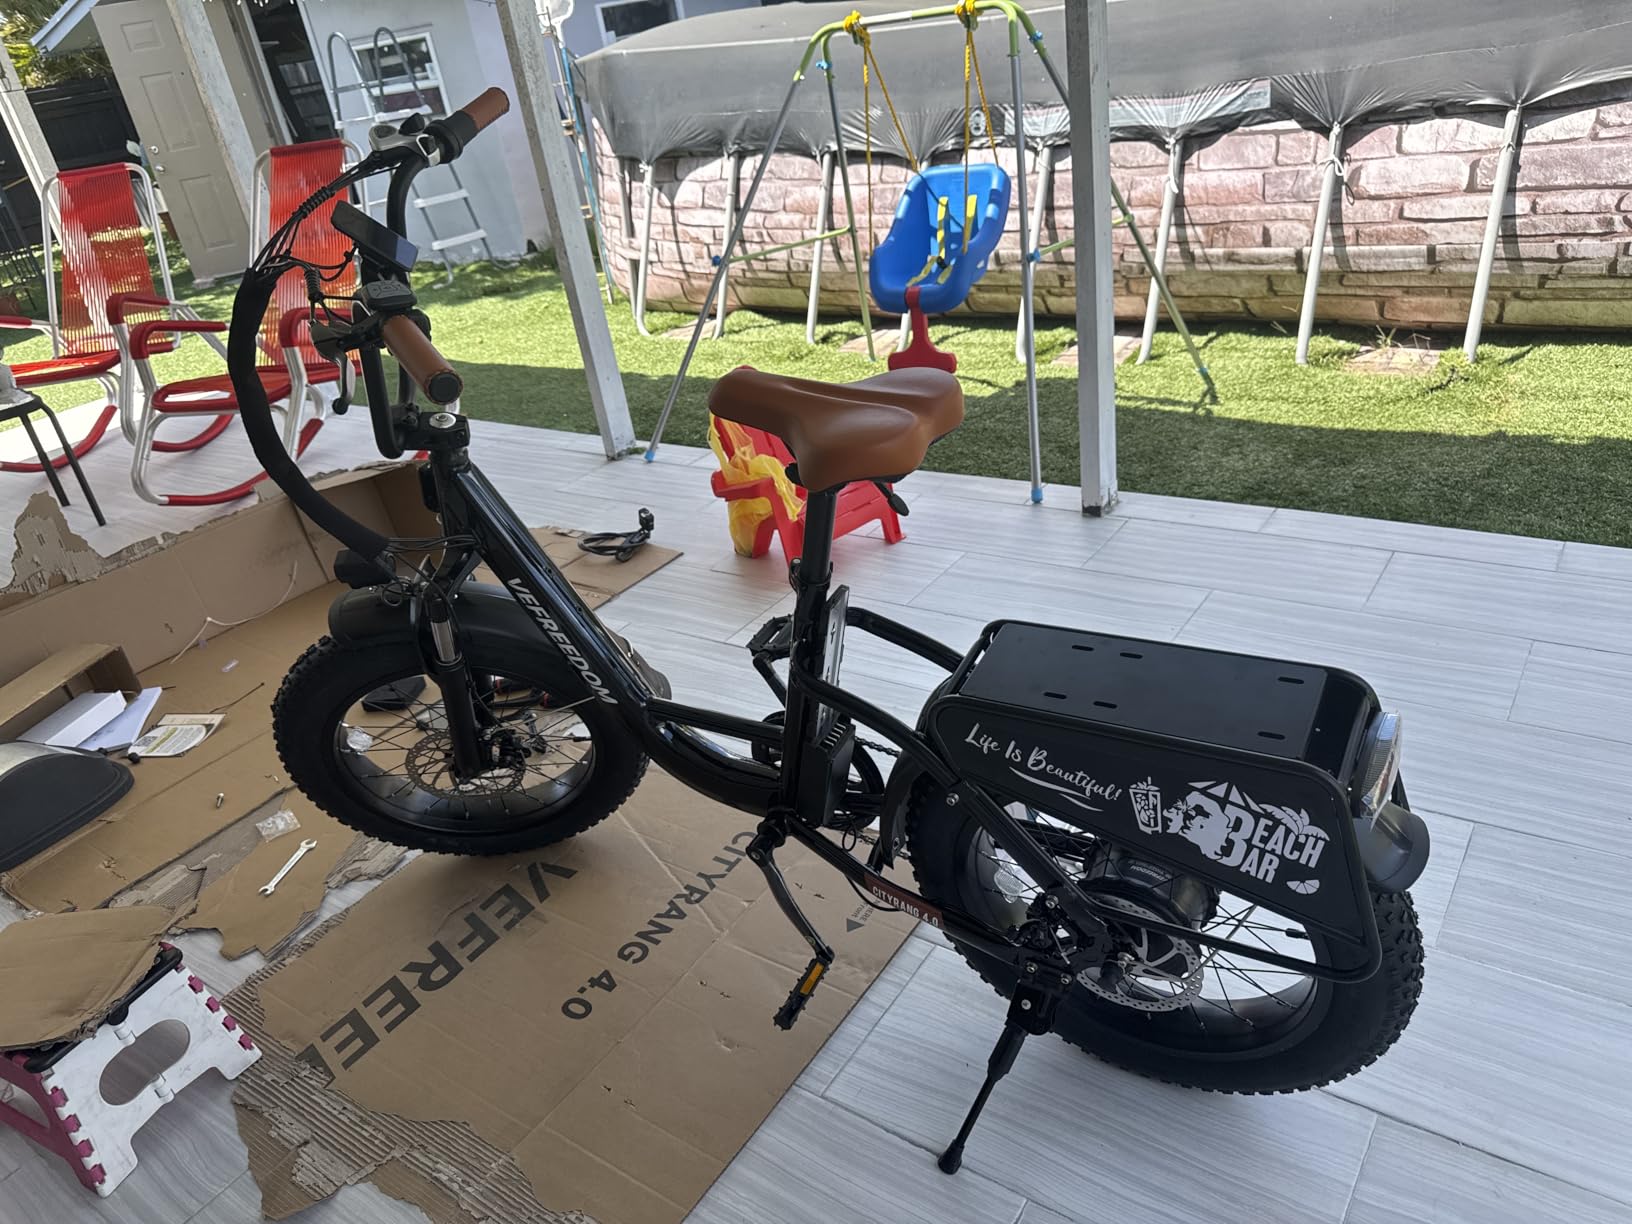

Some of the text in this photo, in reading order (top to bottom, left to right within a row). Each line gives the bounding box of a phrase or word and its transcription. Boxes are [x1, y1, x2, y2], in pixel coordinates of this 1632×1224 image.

[507, 578, 618, 704] VEFREEDOM
[964, 723, 1122, 800] Life Is Beautiful!
[1216, 804, 1325, 869] BEACH
[872, 886, 938, 927] CITYRANG 4.0
[561, 969, 617, 1020] 4.0
